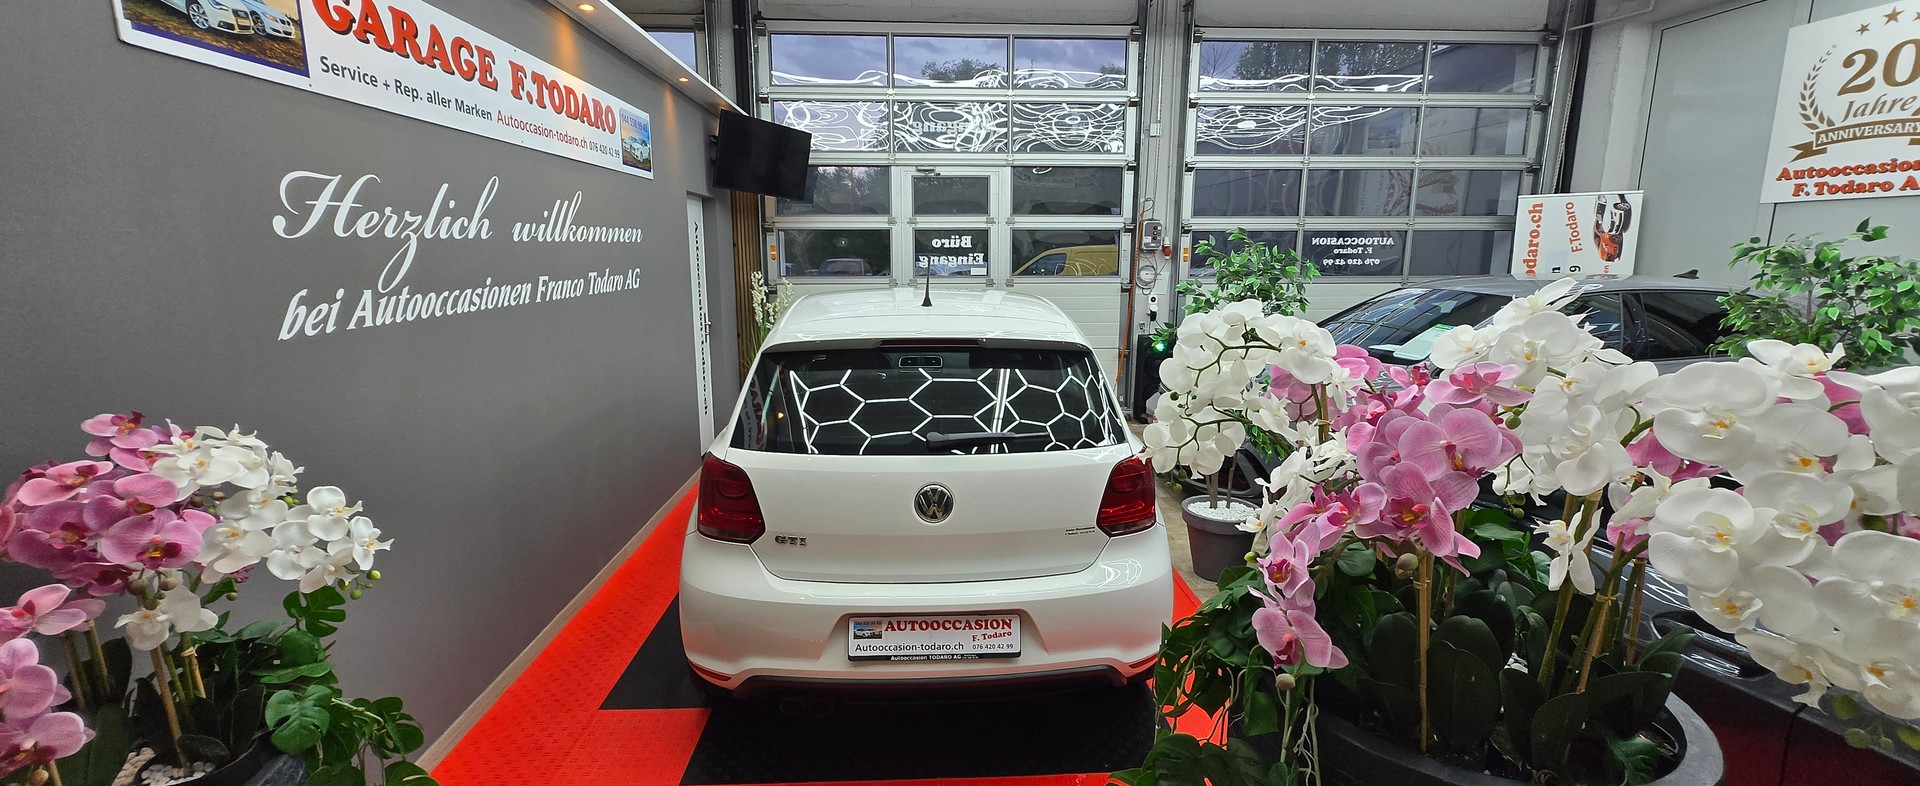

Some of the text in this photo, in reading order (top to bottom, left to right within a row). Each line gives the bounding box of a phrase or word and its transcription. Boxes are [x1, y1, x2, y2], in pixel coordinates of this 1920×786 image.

[312, 0, 617, 134] GARAGE F.TODARO
[1837, 38, 1920, 96] 20
[320, 55, 378, 88] Service
[394, 78, 423, 103] Rep.
[427, 91, 451, 109] aller
[455, 98, 492, 121] Marken
[497, 110, 588, 149] Autooccasion-todaro.ch
[589, 141, 598, 153] 076
[599, 144, 608, 155] 420
[1840, 93, 1917, 123] Jahre
[1792, 183, 1811, 196] F.
[1813, 180, 1895, 195] Todaro
[272, 170, 643, 293] Herzlich willkommen
[278, 267, 640, 341] bei Autooccasionen Franco Todaro AG
[775, 535, 807, 546] GTI
[884, 619, 1013, 632] AUTOOCCASION
[981, 631, 1012, 641] Todaro
[855, 642, 964, 652] Autooccasion-todaro.ch
